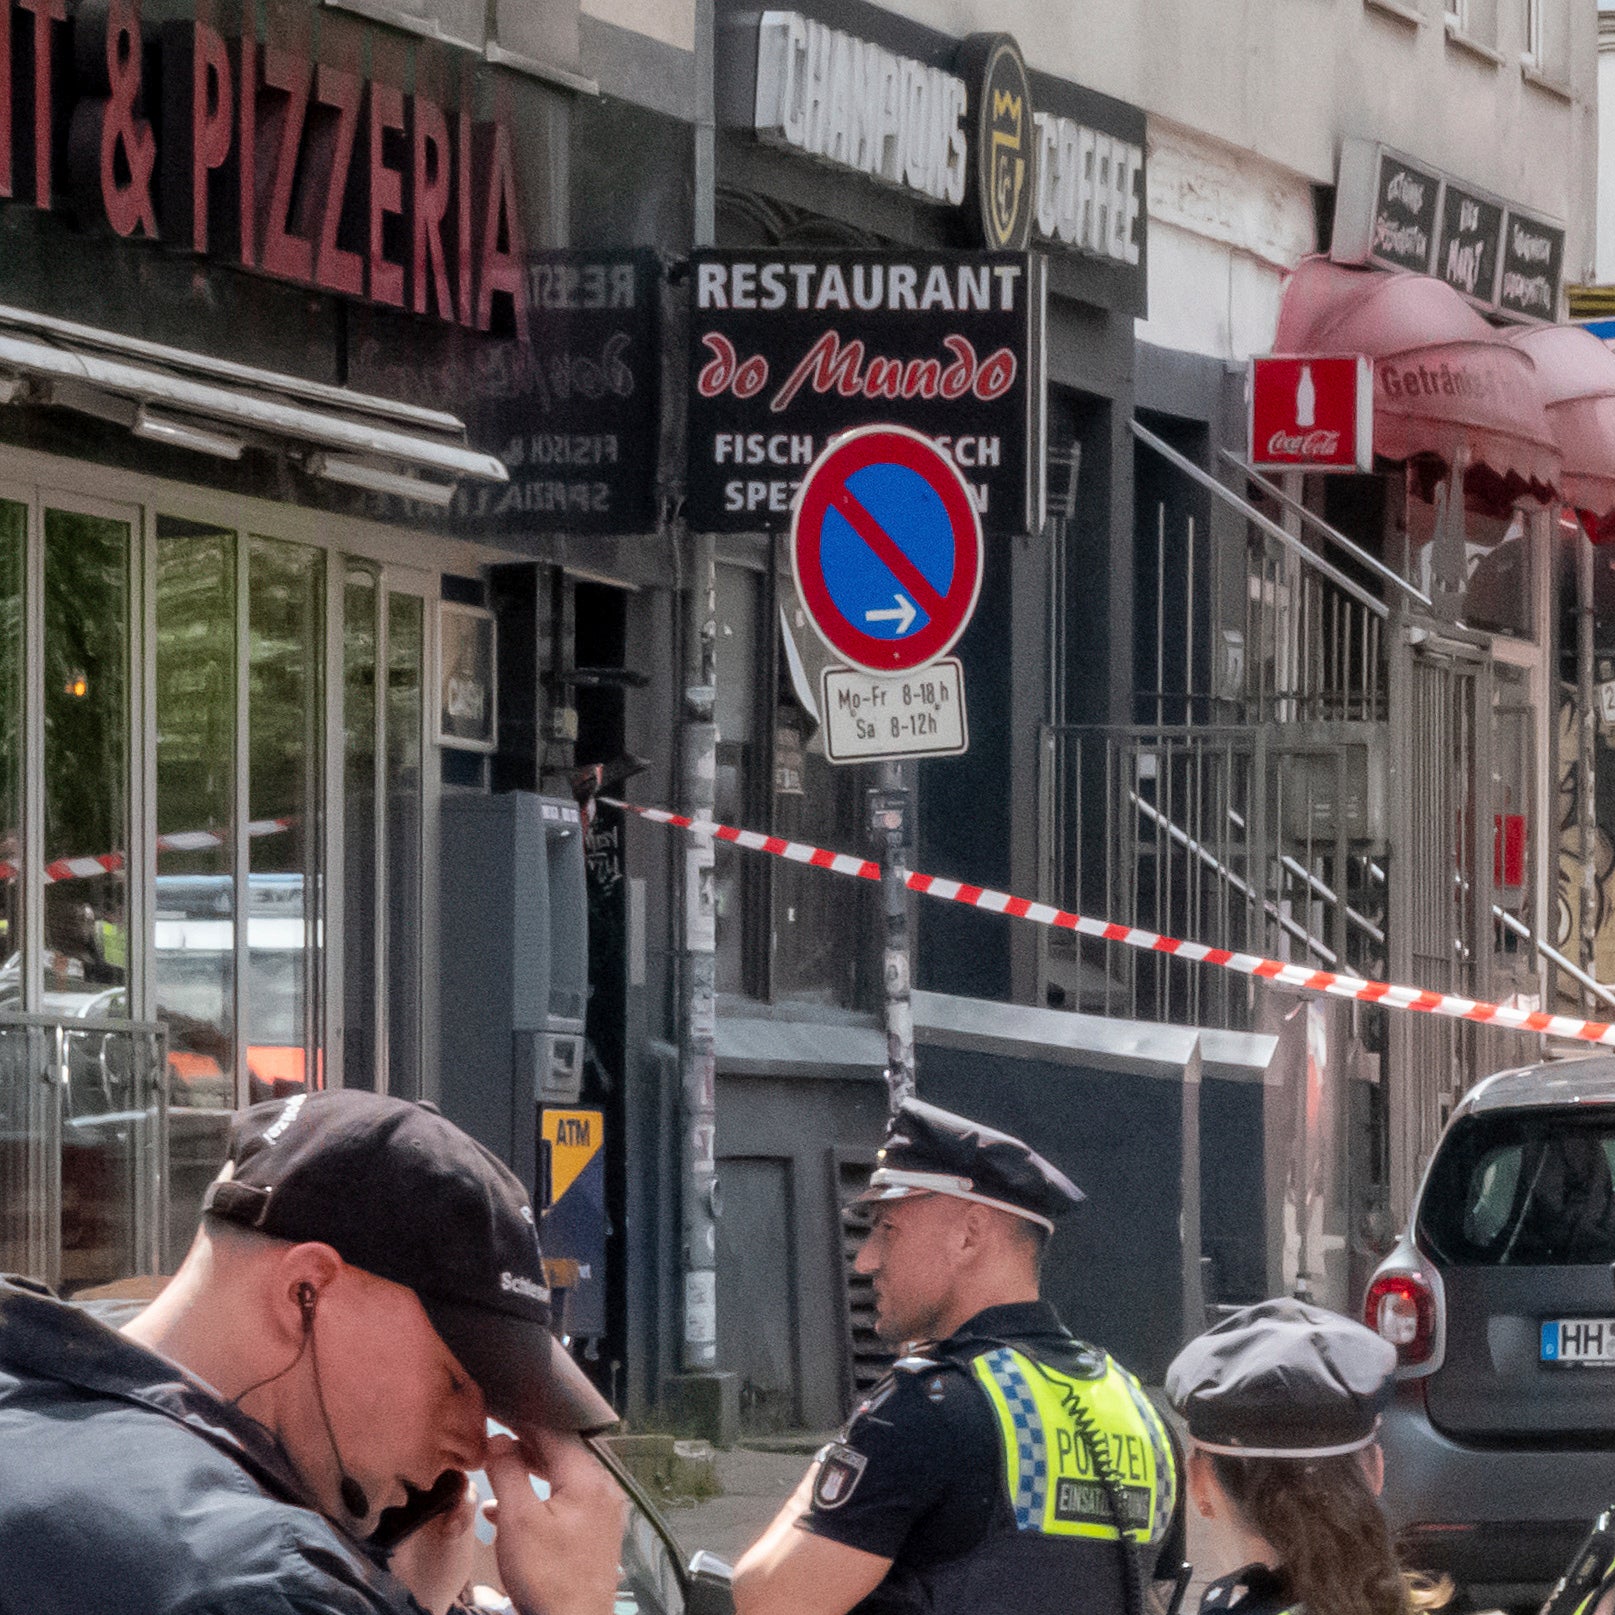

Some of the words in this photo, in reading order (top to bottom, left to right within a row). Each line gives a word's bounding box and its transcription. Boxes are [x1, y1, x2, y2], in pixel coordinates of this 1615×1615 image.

[100, 0, 159, 240] &
[193, 12, 531, 343] PIZZERIA
[1033, 111, 1143, 265] COFFEE
[698, 263, 1020, 311] RESTAURANT
[698, 331, 768, 398] do
[770, 330, 1017, 412] Mundo
[714, 434, 813, 465] FISCH
[838, 685, 889, 710] Mo-Fr
[902, 682, 935, 706] 8-18
[940, 681, 949, 702] h
[856, 718, 876, 739] Sa
[555, 1118, 591, 1147] ATM
[1561, 1323, 1603, 1355] HH
[1056, 1428, 1147, 1481] POIZEI
